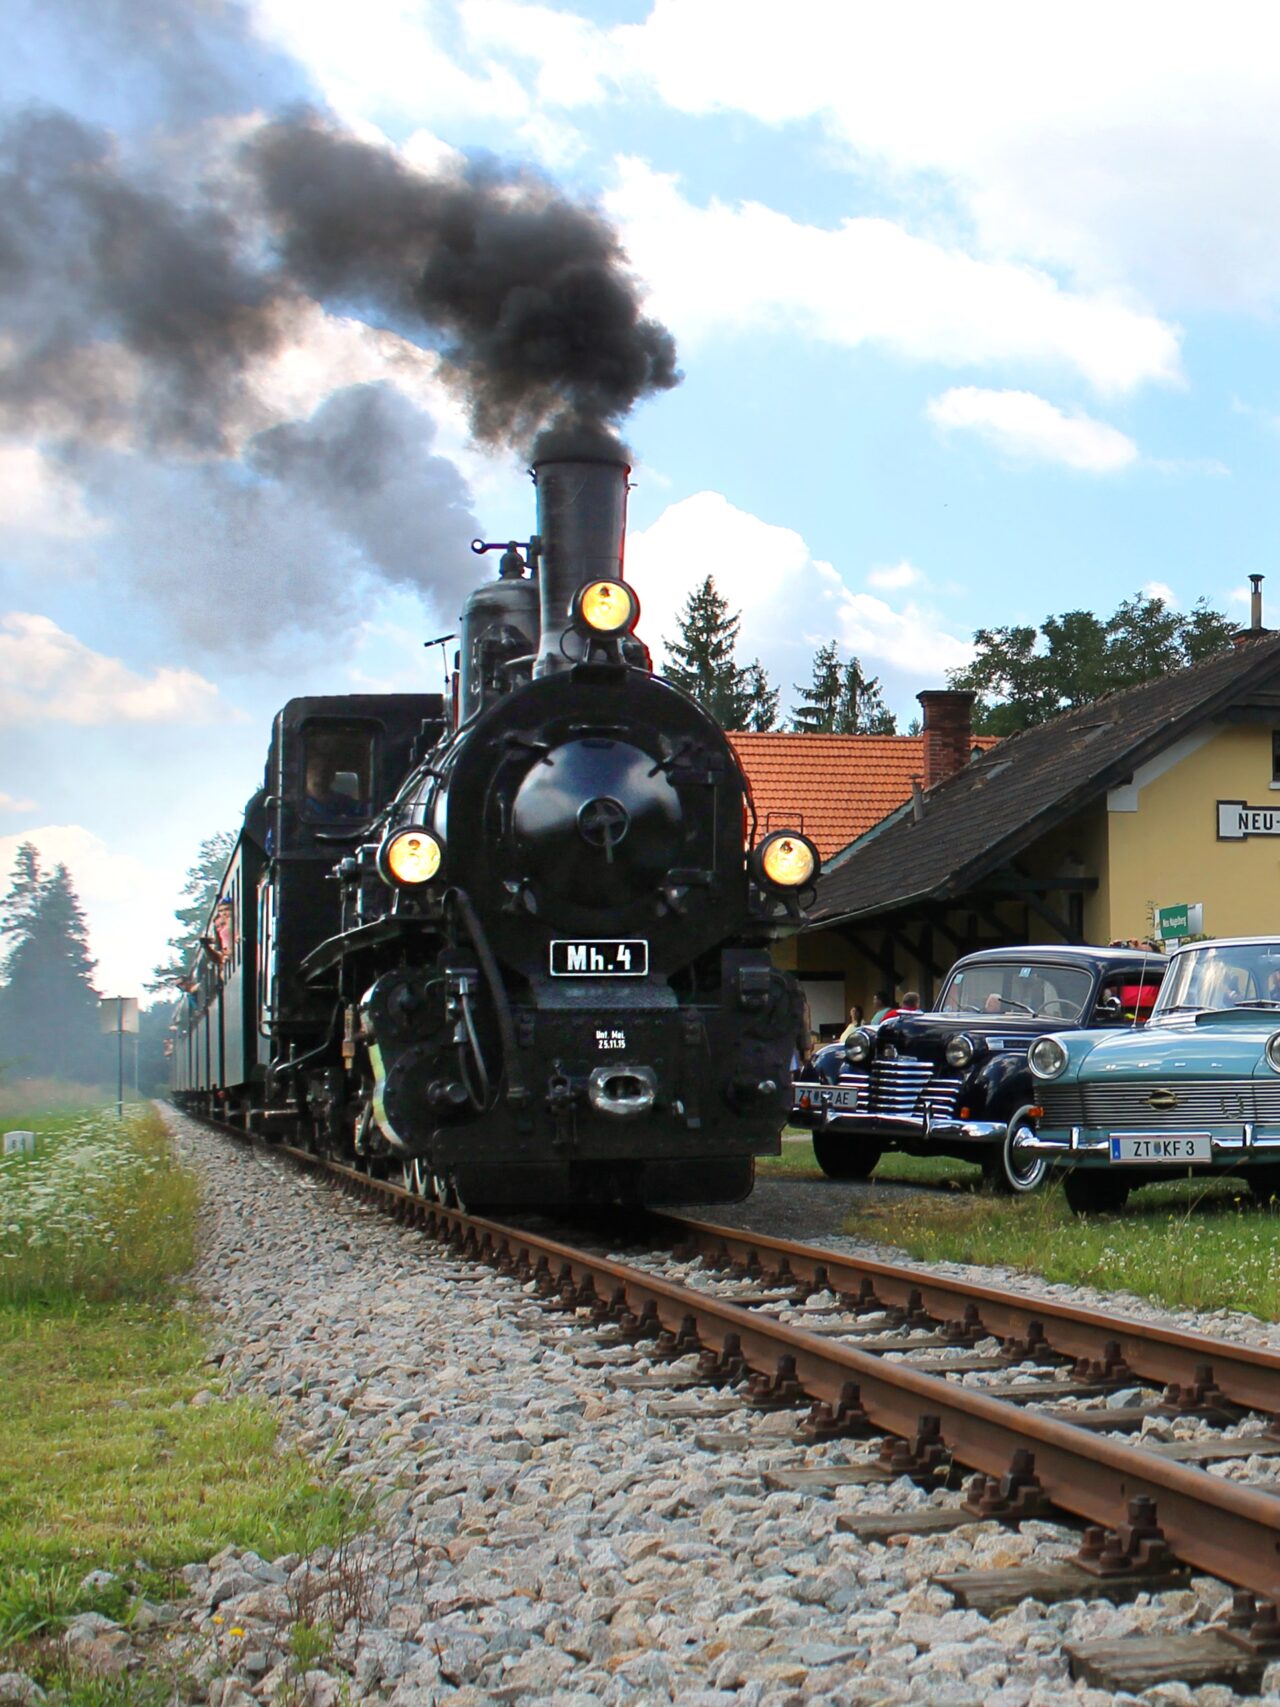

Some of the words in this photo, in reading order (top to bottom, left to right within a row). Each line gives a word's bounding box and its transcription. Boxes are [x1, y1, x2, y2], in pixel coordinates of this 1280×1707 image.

[567, 944, 631, 971] Mh.4
[835, 1091, 850, 1105] AE
[1133, 1140, 1151, 1157] ZT
[1163, 1140, 1181, 1156] KF
[1186, 1140, 1195, 1156] 3
